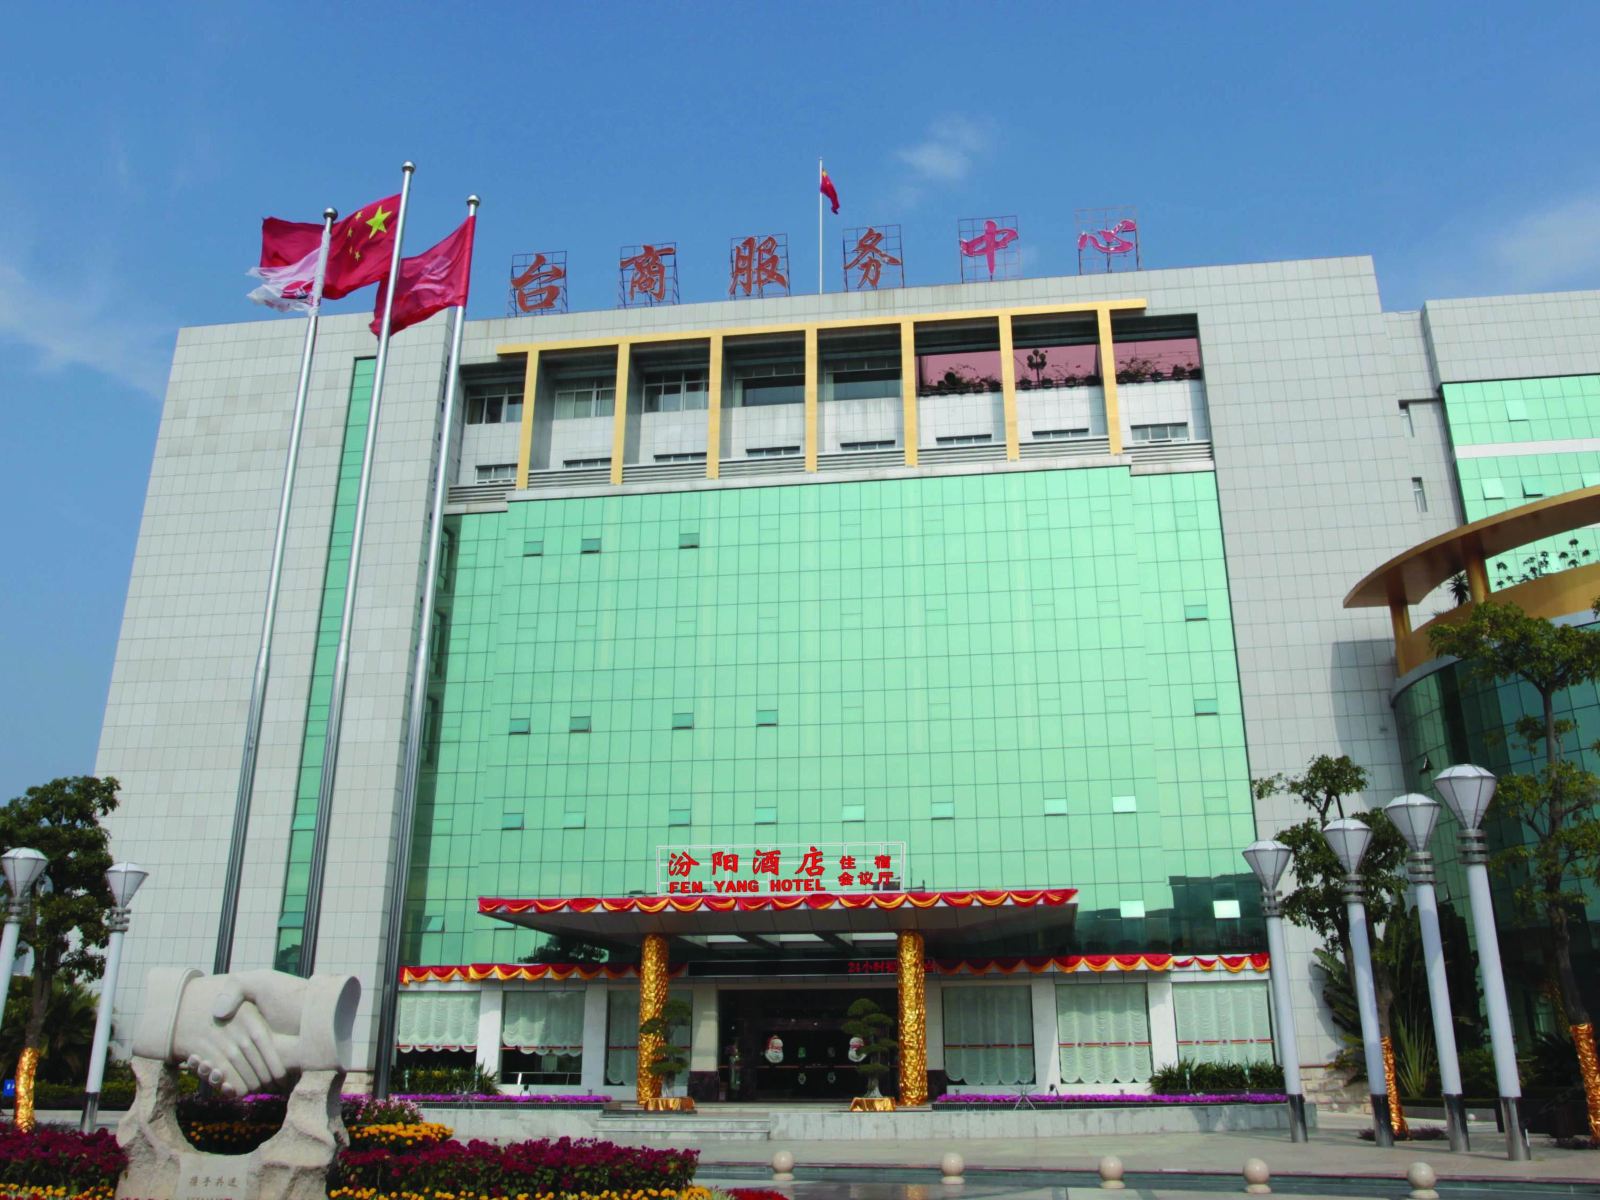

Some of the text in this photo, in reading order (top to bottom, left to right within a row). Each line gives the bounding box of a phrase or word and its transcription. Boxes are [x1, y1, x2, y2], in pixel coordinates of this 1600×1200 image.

[511, 219, 1137, 312] 台商服务中心
[668, 846, 826, 876] 汾阳酒店
[840, 855, 891, 870] 住宿
[669, 878, 826, 894] FEN YANG HOTEL
[838, 871, 894, 886] 会议厅
